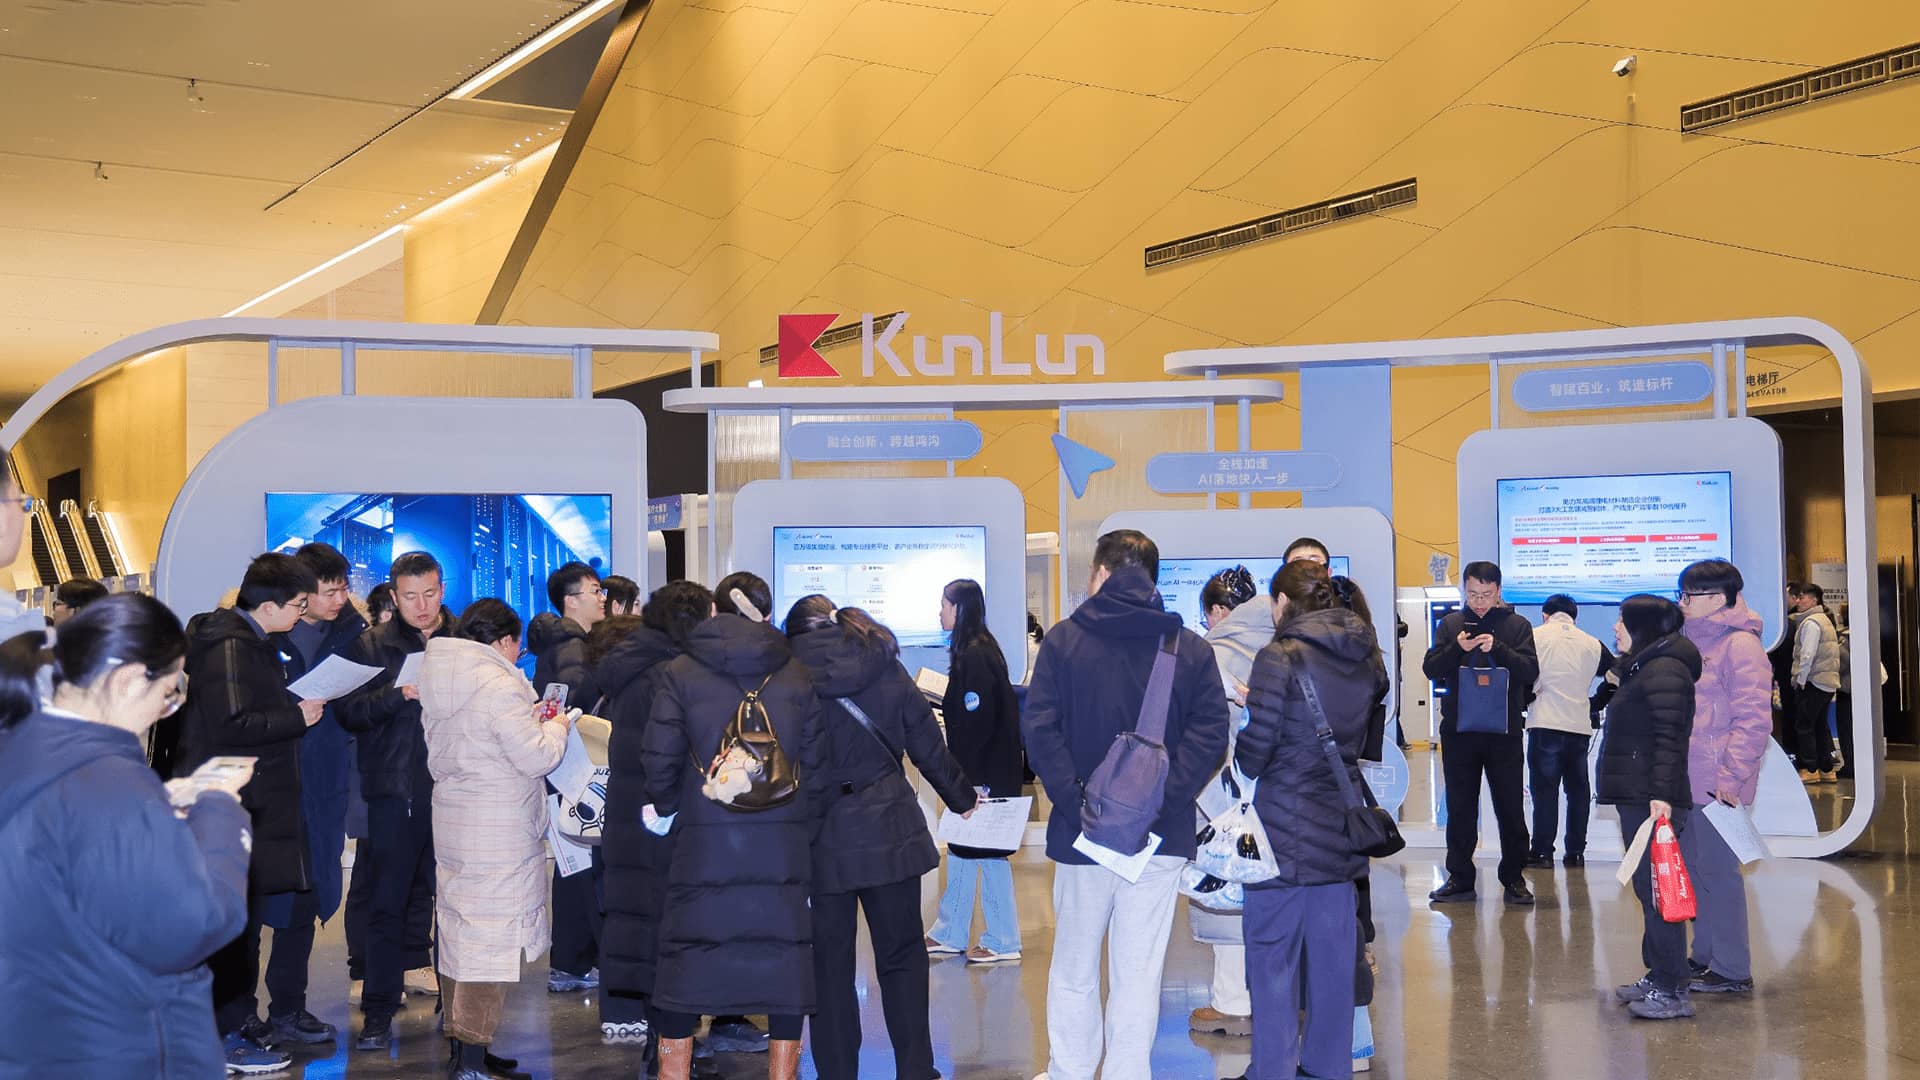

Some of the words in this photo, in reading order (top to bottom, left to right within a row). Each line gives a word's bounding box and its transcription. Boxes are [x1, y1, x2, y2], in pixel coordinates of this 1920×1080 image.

[861, 311, 1105, 377] KunLun
[1218, 457, 1270, 471] 全栈加速
[1198, 472, 1289, 486] AI落地快人一步
[1429, 555, 1449, 582] 智
